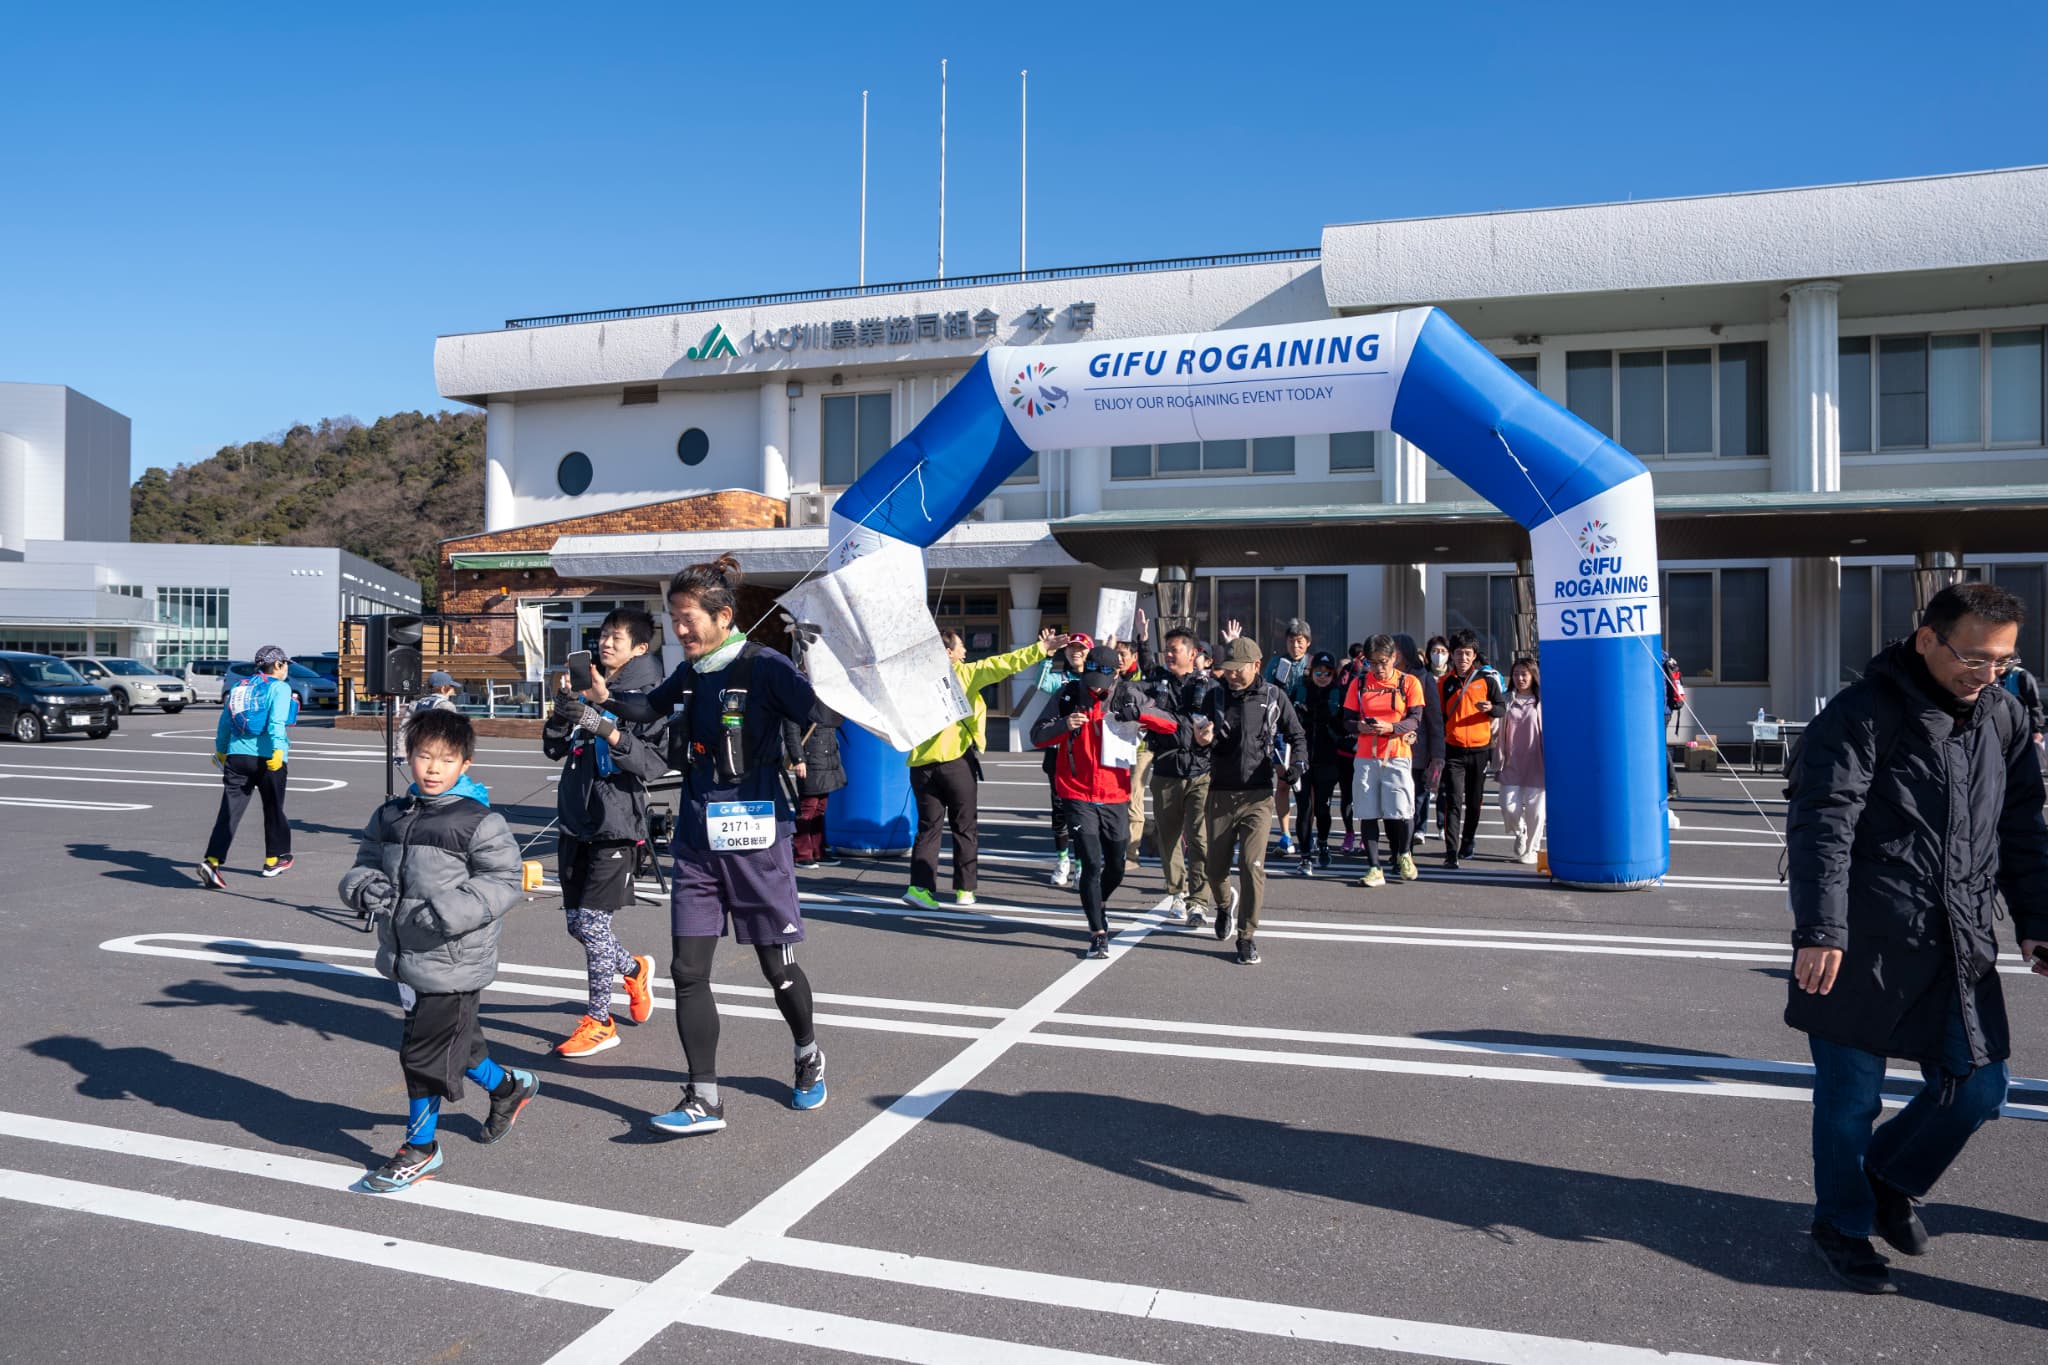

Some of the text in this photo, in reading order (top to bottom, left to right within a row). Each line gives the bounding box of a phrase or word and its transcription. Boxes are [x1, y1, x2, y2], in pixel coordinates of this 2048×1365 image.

[750, 307, 1000, 353] いび川農業協同組合
[1089, 334, 1380, 378] GIFU ROGAINING
[1094, 386, 1334, 411] ENJOY OUR ROGAINING EVENT TODAY
[1578, 556, 1622, 576] GIFU
[1554, 575, 1649, 599] ROGAINING
[1560, 604, 1648, 636] START
